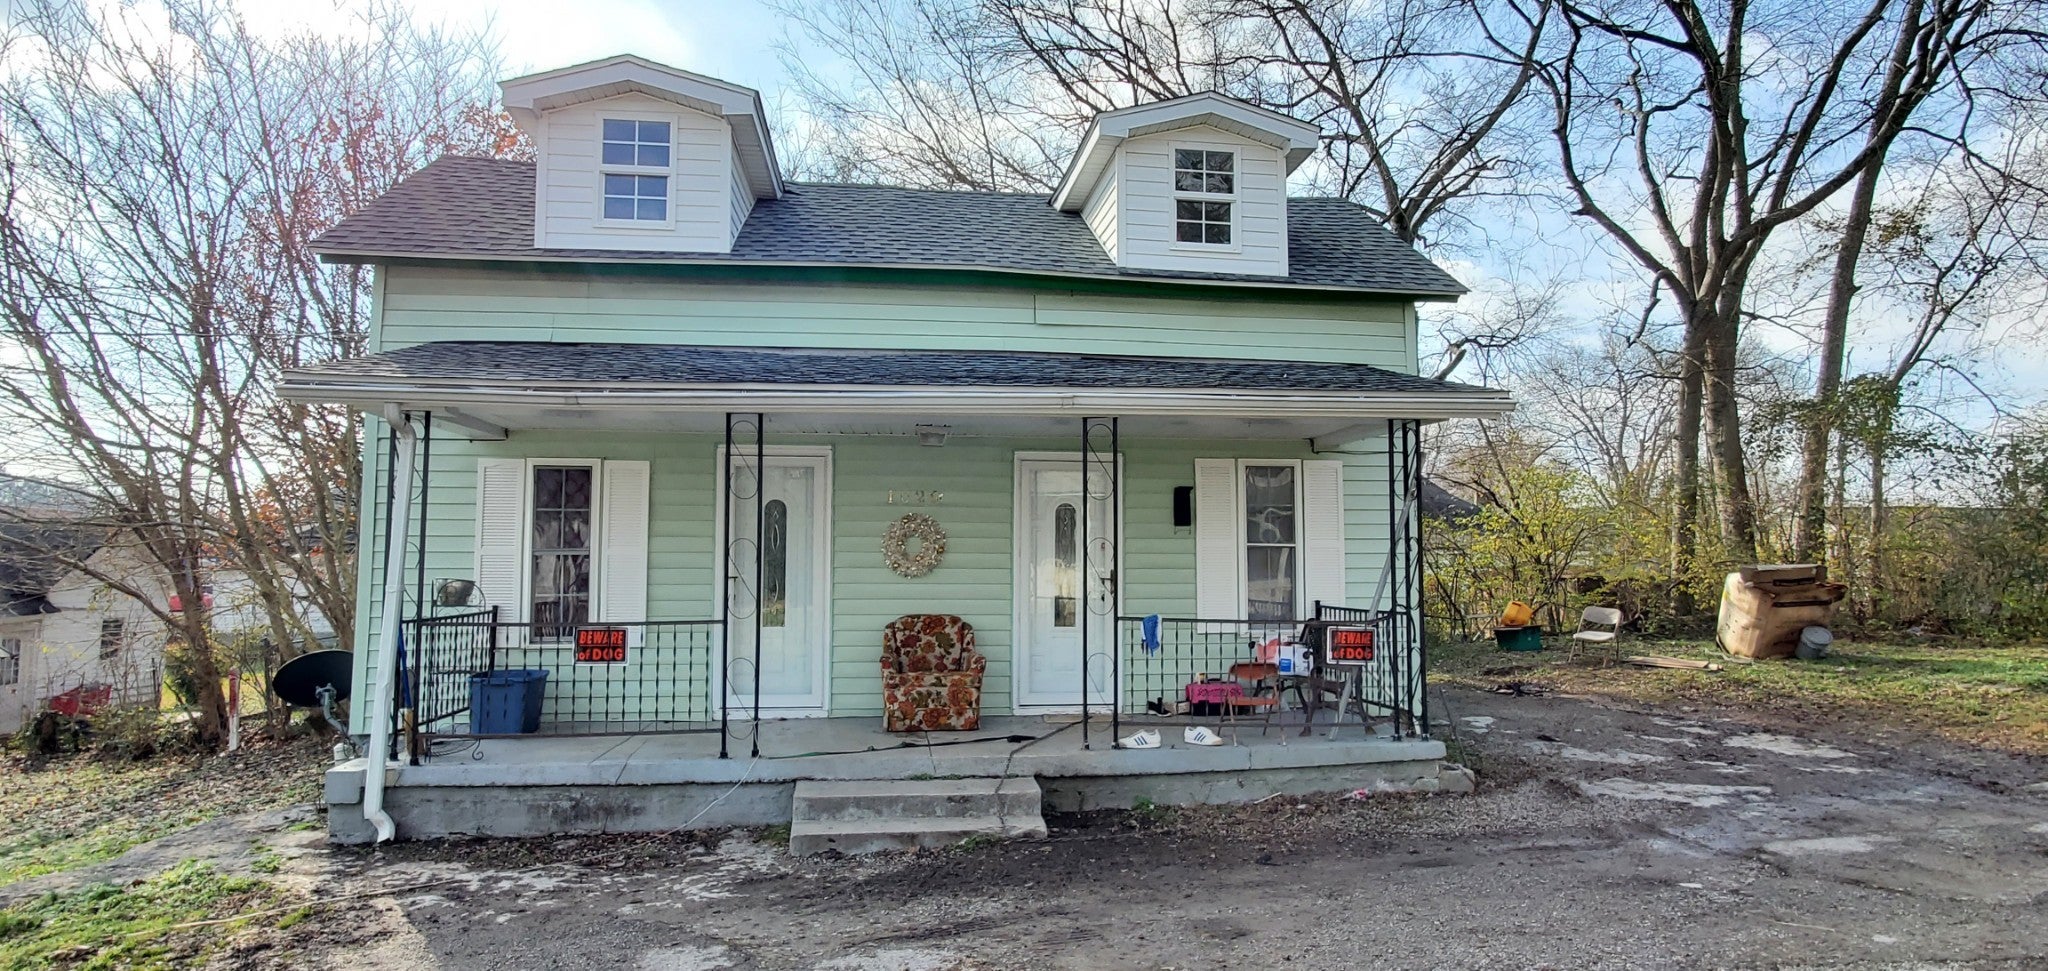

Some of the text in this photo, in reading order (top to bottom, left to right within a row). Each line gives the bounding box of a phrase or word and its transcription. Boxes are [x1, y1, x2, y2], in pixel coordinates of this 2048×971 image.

[579, 631, 624, 644] BEWARE
[1334, 632, 1372, 644] BEWARE
[579, 648, 623, 660] of DOG
[1346, 647, 1372, 659] DOG
